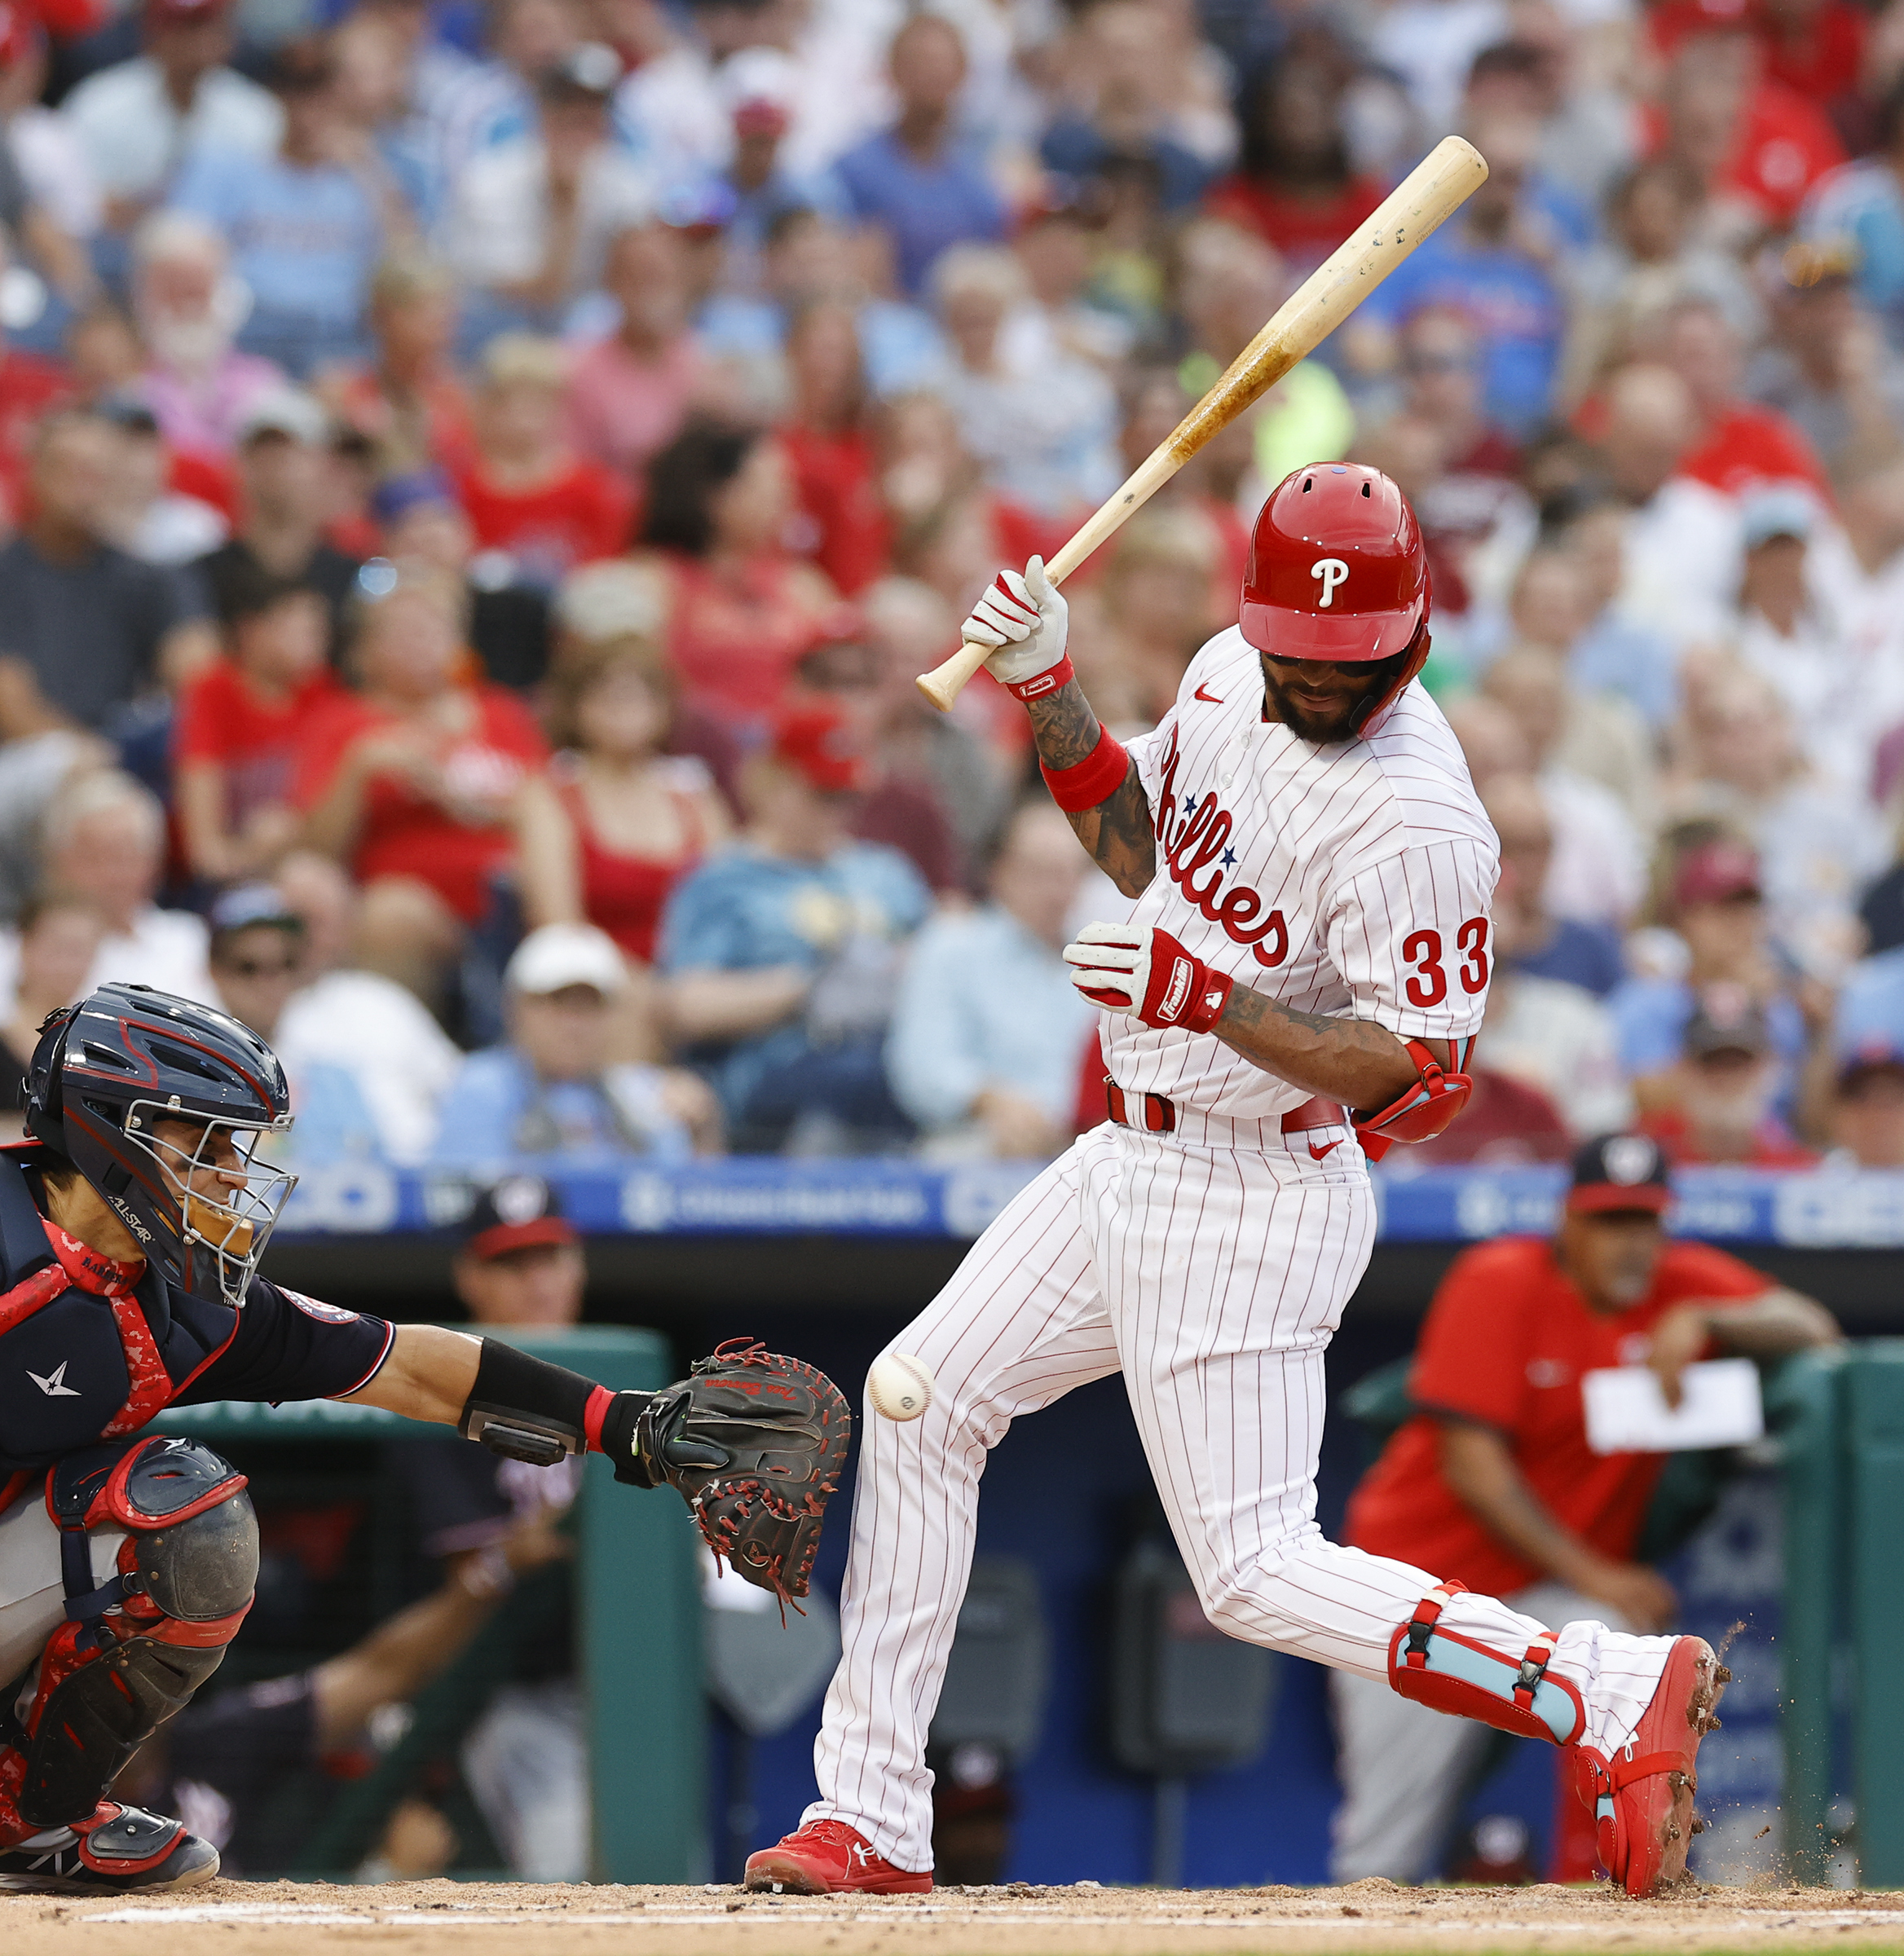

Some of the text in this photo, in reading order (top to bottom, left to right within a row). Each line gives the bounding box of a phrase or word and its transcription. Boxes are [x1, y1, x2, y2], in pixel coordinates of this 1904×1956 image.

[1311, 557, 1350, 608] P
[1162, 960, 1189, 1019] Franklin
[1402, 917, 1488, 1007] 33
[107, 1195, 152, 1244] ALL-STAR
